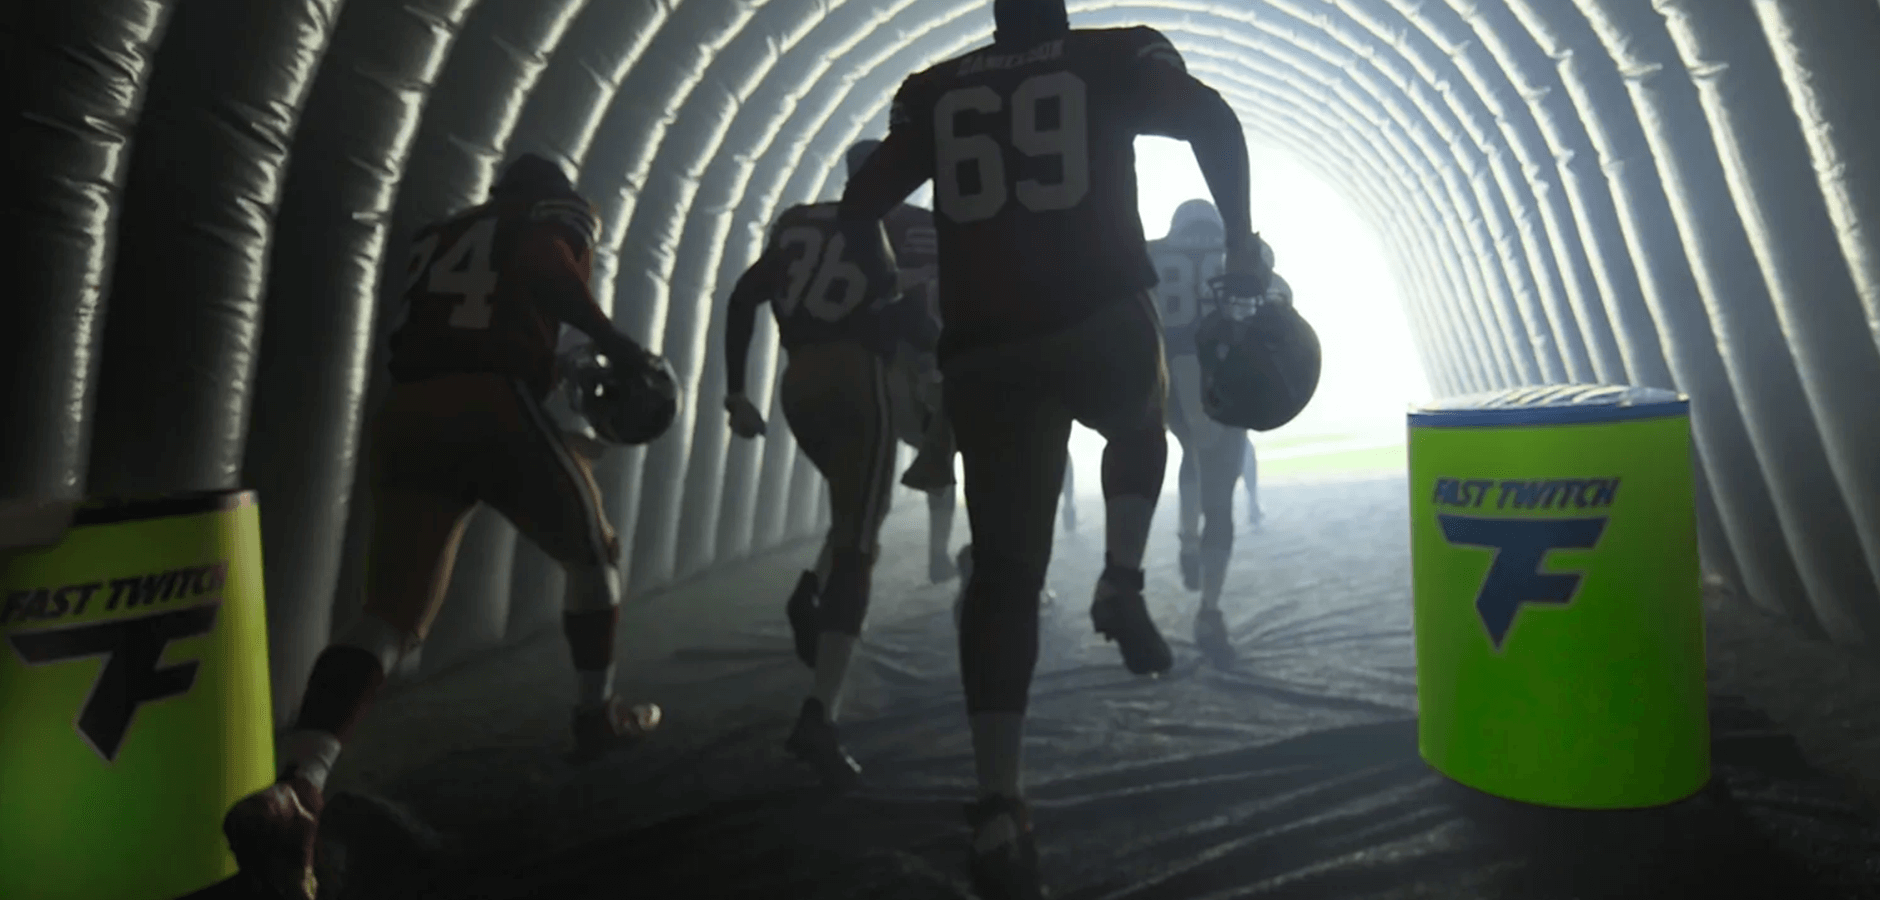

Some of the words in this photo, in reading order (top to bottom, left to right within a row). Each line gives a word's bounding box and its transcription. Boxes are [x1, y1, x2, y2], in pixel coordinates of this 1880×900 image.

[934, 71, 1090, 223] 69
[774, 226, 868, 322] 36
[1433, 479, 1494, 508] FAST
[1497, 476, 1621, 510] TWITCH
[1, 583, 104, 623] FAST
